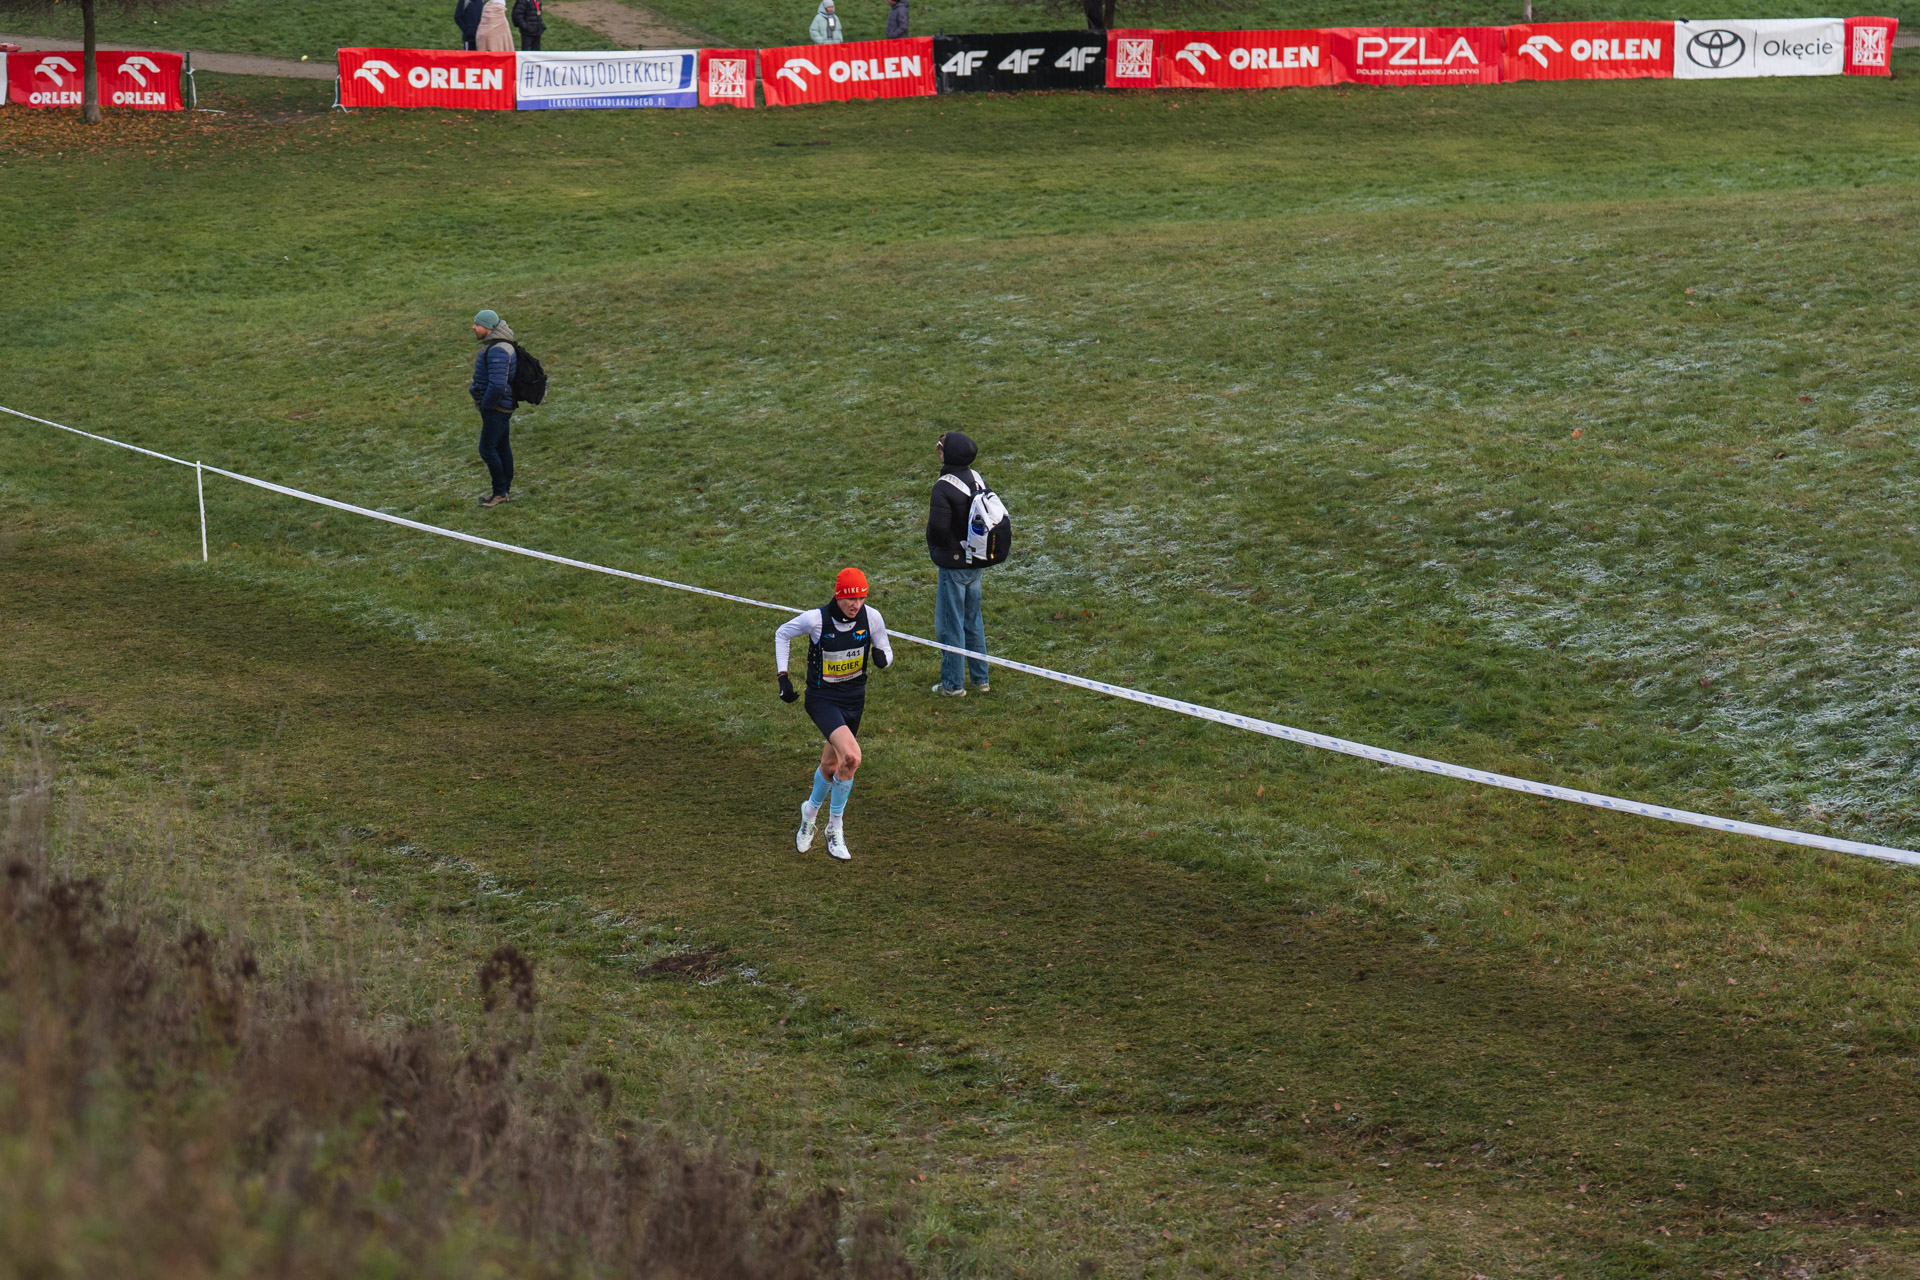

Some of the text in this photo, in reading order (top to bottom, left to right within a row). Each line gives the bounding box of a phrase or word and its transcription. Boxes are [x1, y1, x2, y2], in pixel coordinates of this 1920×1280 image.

[1054, 46, 1101, 71] 4F
[1228, 45, 1319, 70] ORLEN
[1356, 36, 1479, 65] PZLA
[1570, 38, 1661, 61] ORLEN
[1763, 37, 1834, 60] Okęcie
[828, 54, 921, 83] ORLEN
[941, 50, 987, 75] 4F
[997, 48, 1044, 73] 4F
[1118, 63, 1150, 76] PZLA
[1356, 68, 1383, 76] POLSKI
[407, 66, 503, 90] ORLEN
[711, 83, 744, 95] PZLA
[29, 91, 82, 105] ORLEN
[112, 91, 166, 105] ORLEN
[846, 649, 861, 658] 441
[828, 660, 859, 672] MEGIER
